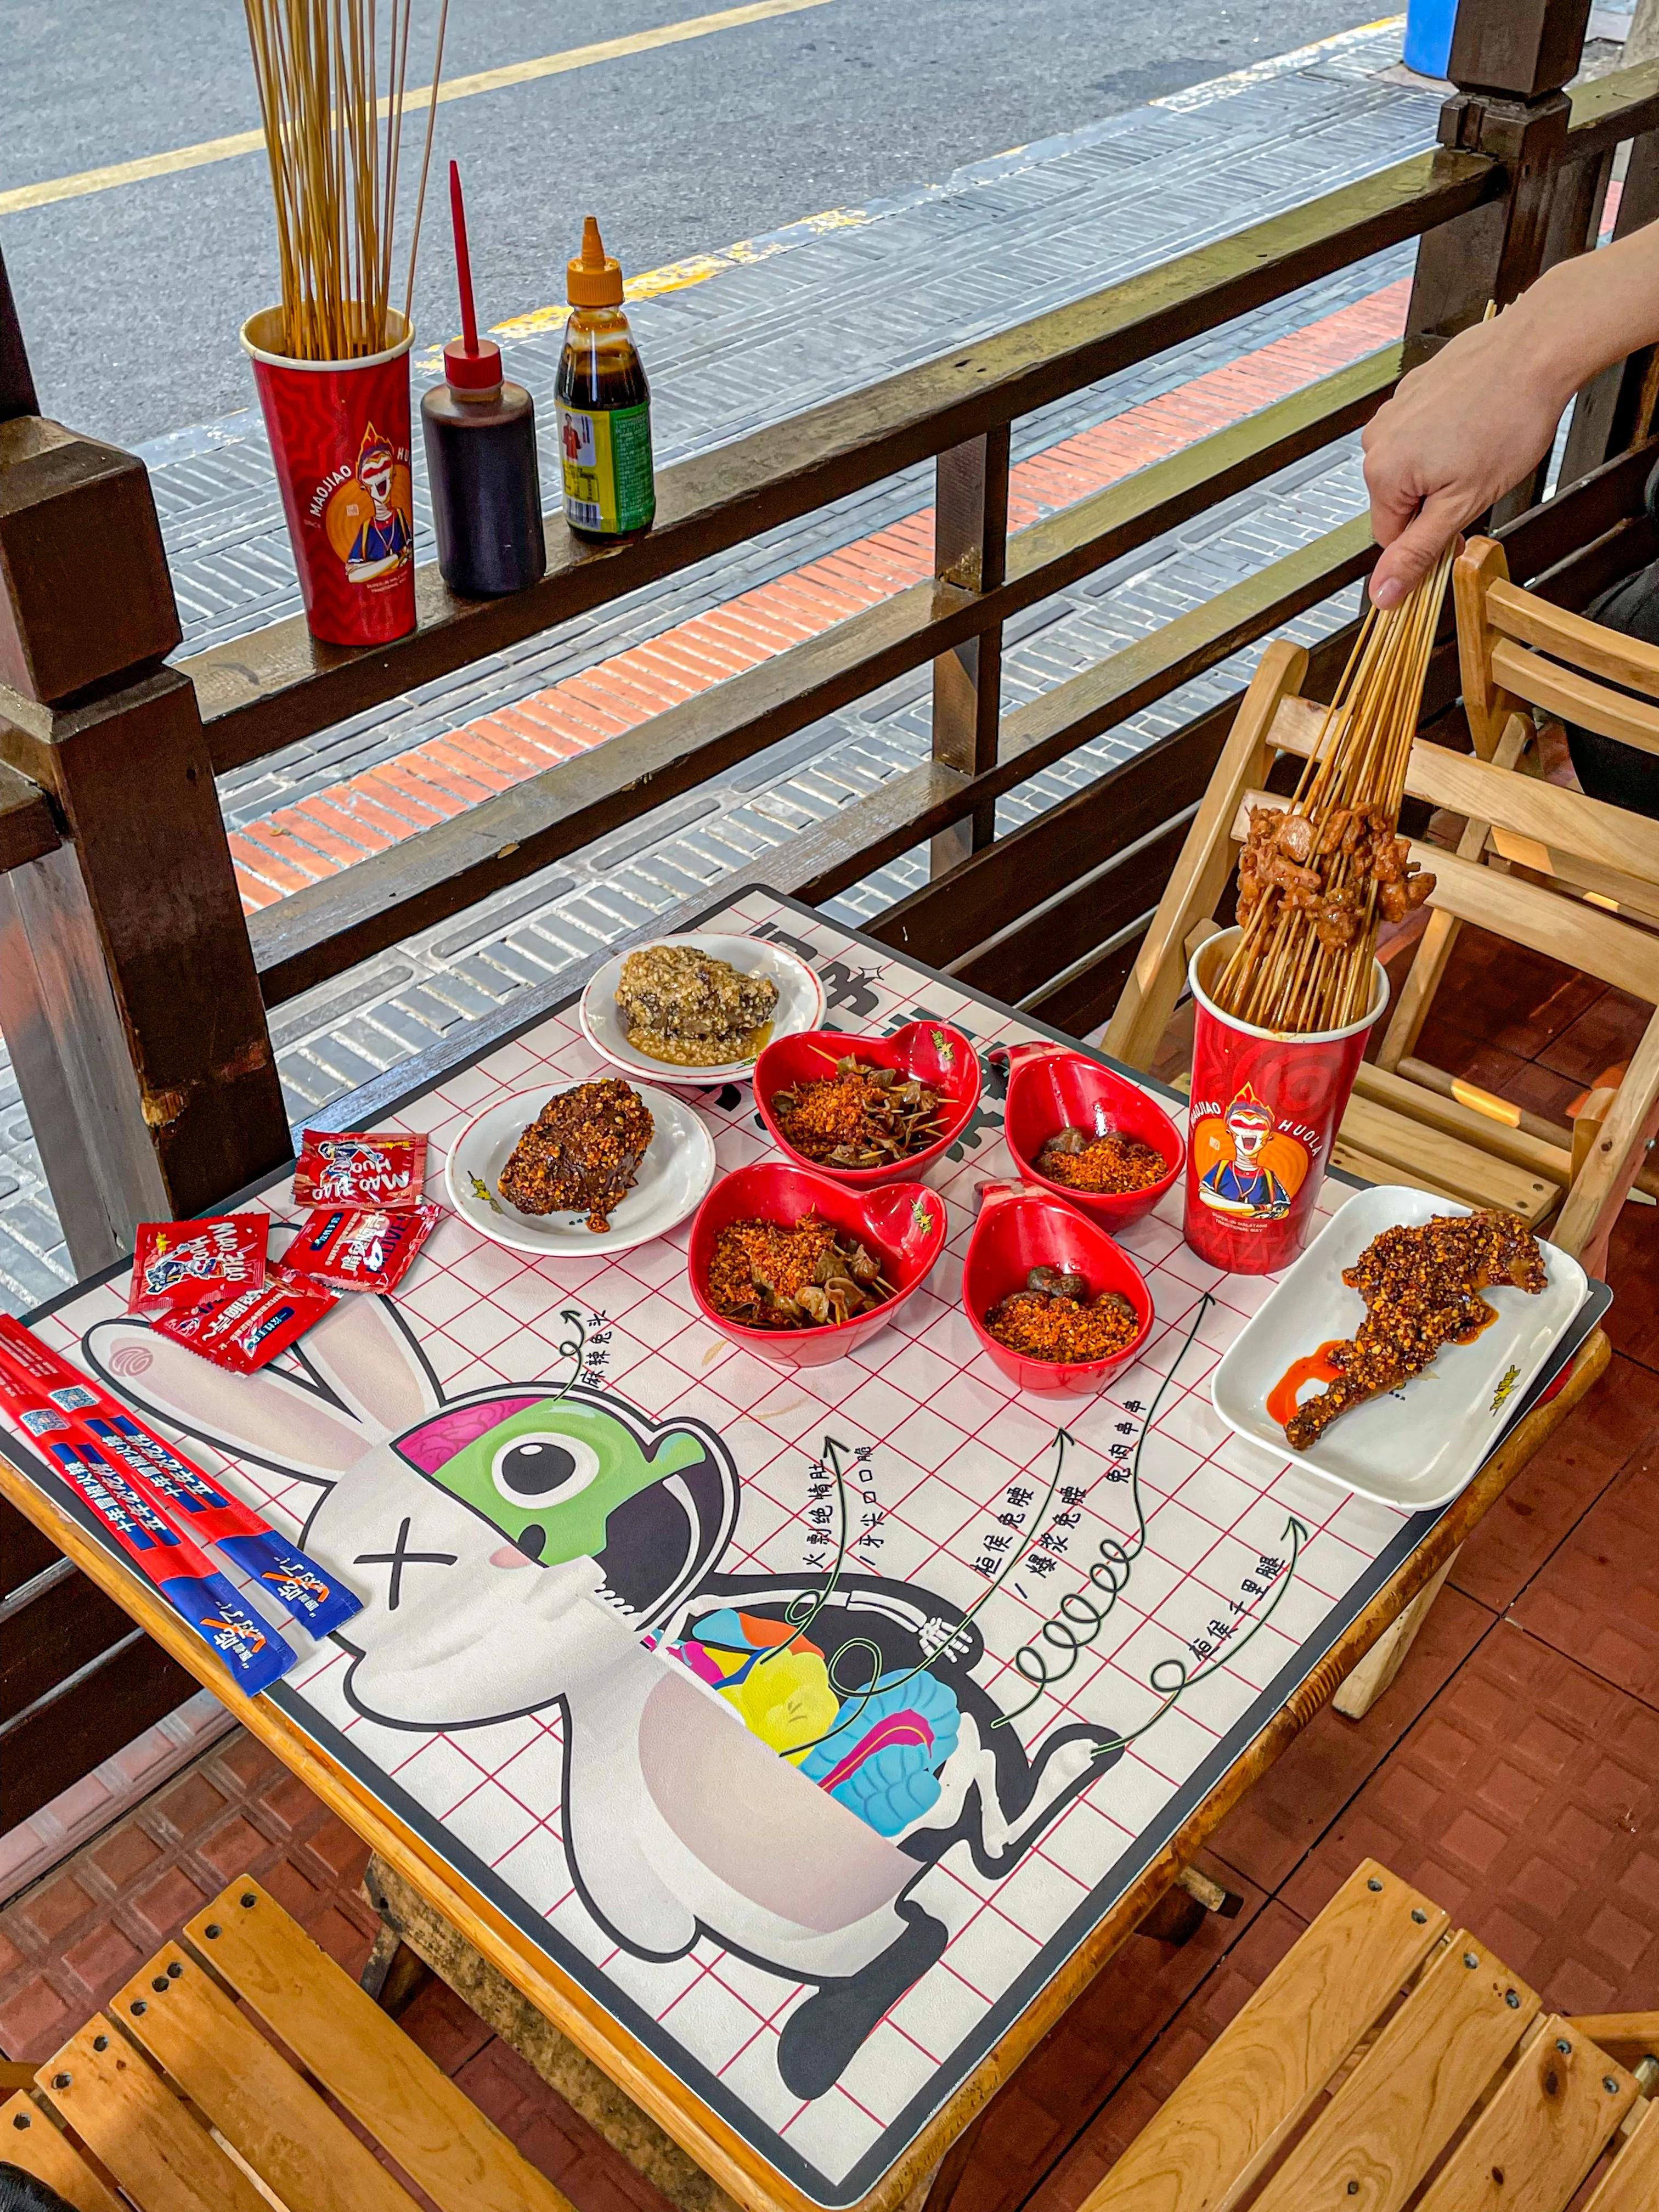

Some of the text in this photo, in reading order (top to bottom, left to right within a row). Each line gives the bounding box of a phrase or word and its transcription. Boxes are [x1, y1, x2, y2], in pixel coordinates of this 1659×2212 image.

[310, 465, 352, 517] MAOJIAO
[1190, 1101, 1323, 1156] MAOJIAO HUOLA
[351, 1158, 391, 1173] HUO
[188, 1234, 212, 1261] HUO
[580, 1310, 612, 1388] 麻辣兔头
[101, 1432, 183, 1498] 十年冒椒火辣
[126, 1431, 213, 1496] 五年必吃榜
[1105, 1400, 1147, 1483] 兔肉串串
[63, 1459, 136, 1532] 十年冒椒火辣
[87, 1461, 167, 1532] 五年必吃榜
[969, 1486, 1035, 1578] 桓侯兔腰
[1189, 1556, 1285, 1661] 桓侯千里腿
